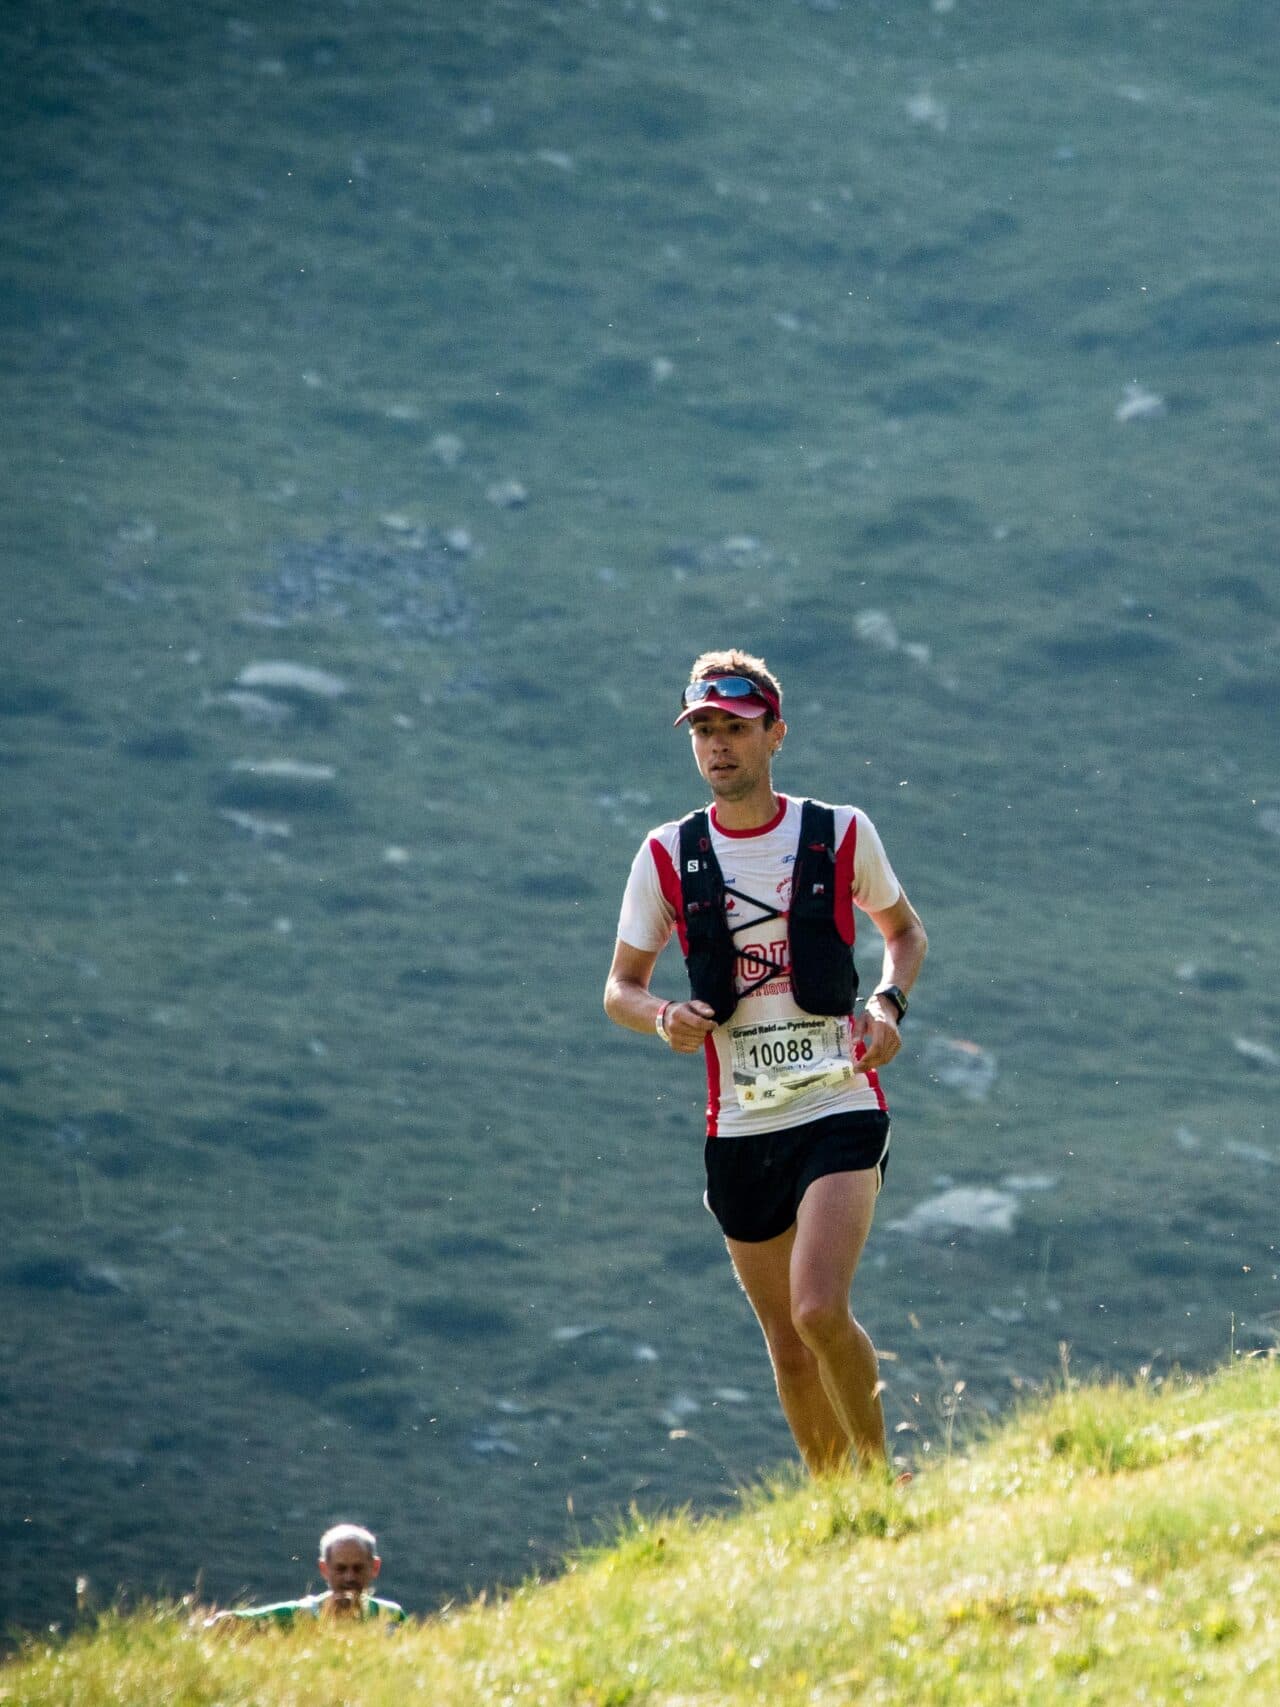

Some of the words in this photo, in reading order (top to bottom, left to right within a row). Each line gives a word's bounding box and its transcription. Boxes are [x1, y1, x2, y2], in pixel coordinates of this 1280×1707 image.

[733, 1028, 757, 1038] Grand
[758, 1024, 776, 1034] Raid
[750, 1039, 813, 1068] 10088
